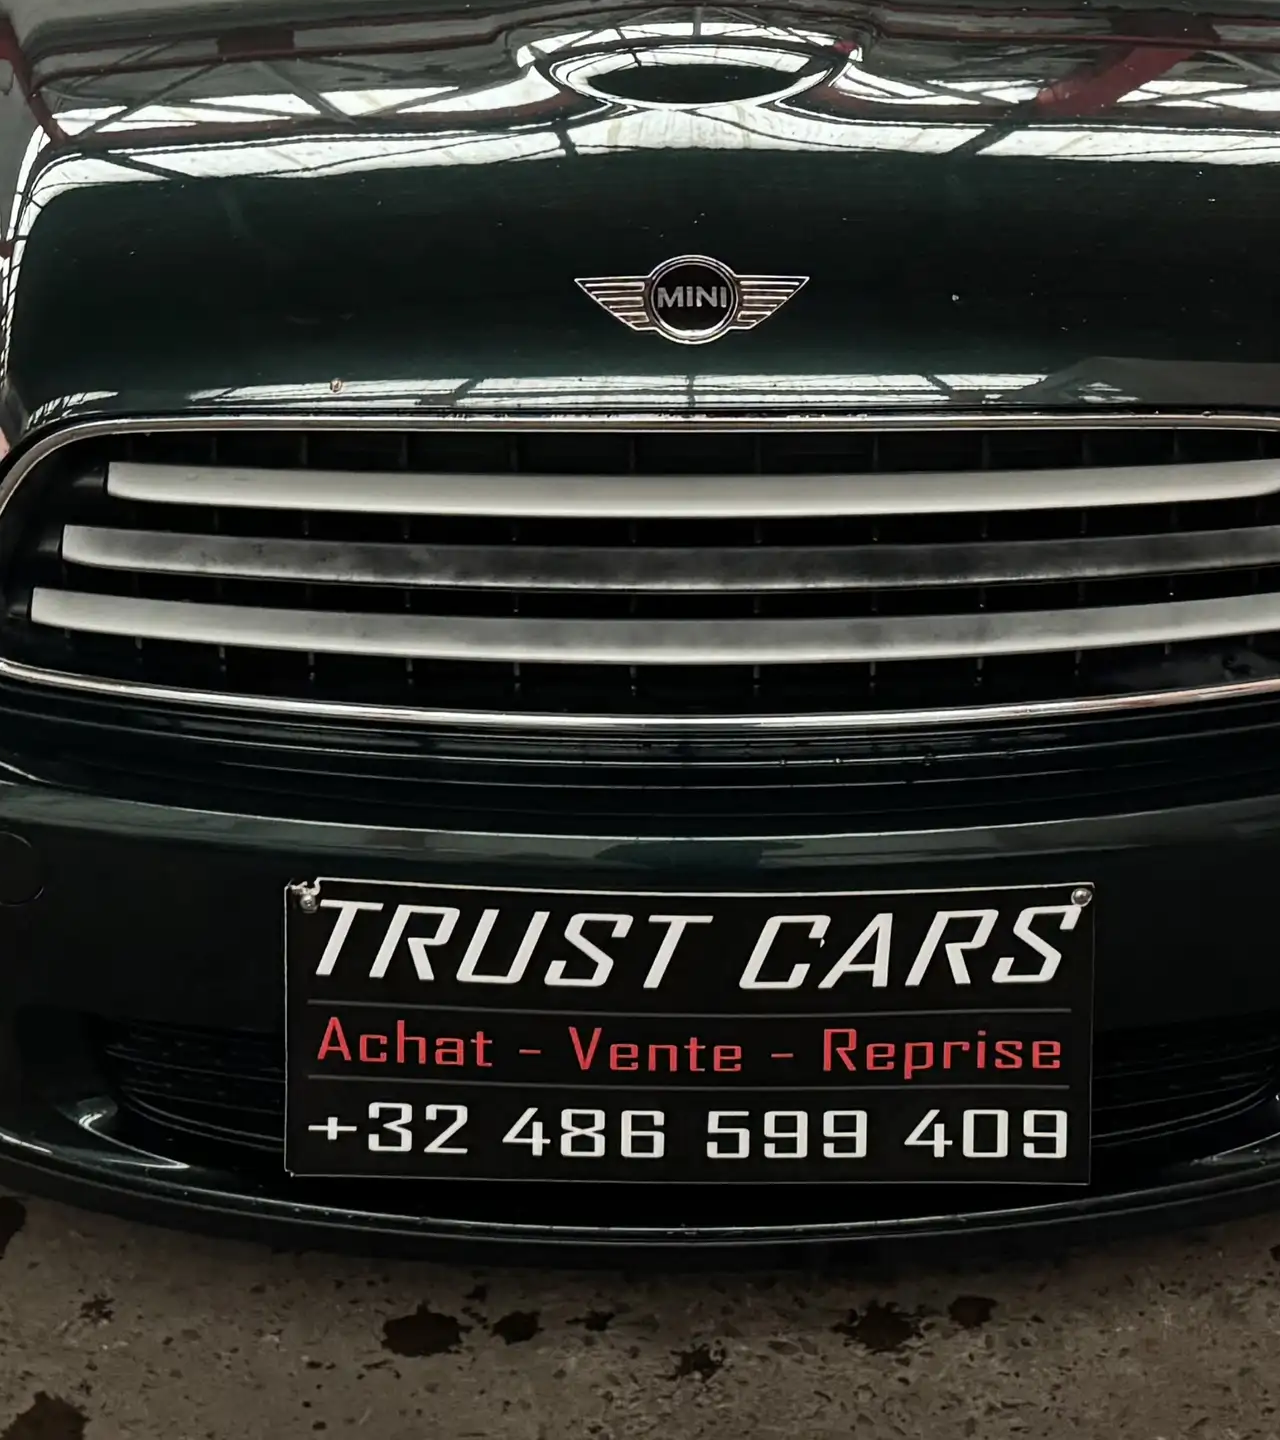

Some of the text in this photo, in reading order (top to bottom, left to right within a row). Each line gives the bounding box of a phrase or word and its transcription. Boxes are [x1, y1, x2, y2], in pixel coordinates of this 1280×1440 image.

[657, 286, 727, 308] MINI
[315, 899, 1082, 991] TRUST CARS
[316, 1016, 493, 1068] Achat
[568, 1026, 744, 1074] Vente
[822, 1027, 1063, 1081] Reprise
[307, 1101, 1069, 1160] +32 486 599 409
